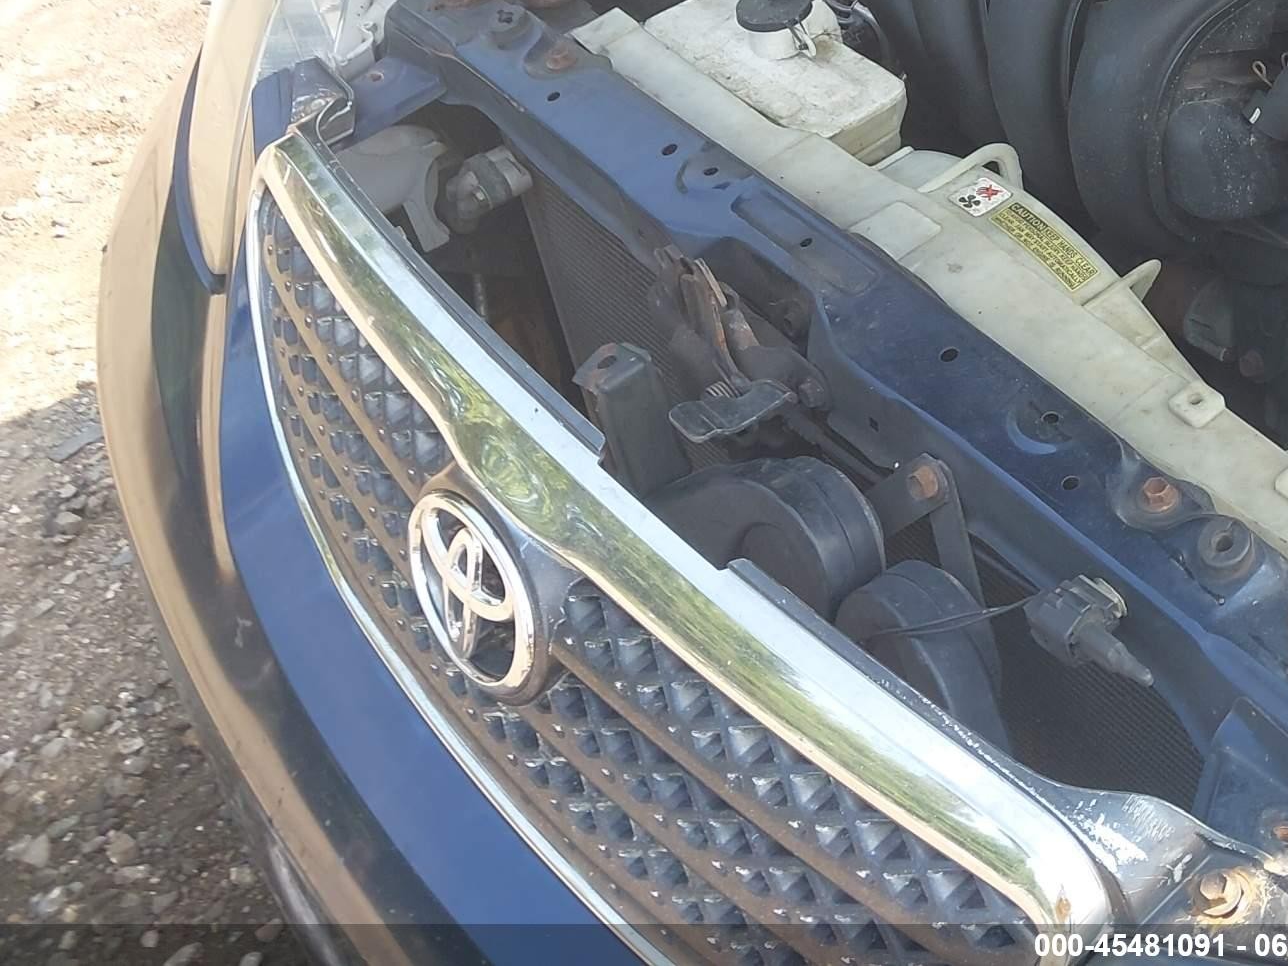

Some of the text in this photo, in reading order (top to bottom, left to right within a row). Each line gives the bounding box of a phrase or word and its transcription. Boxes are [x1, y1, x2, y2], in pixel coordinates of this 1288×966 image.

[1011, 203, 1097, 274] CAUTION KEEP HANDS CLEAR
